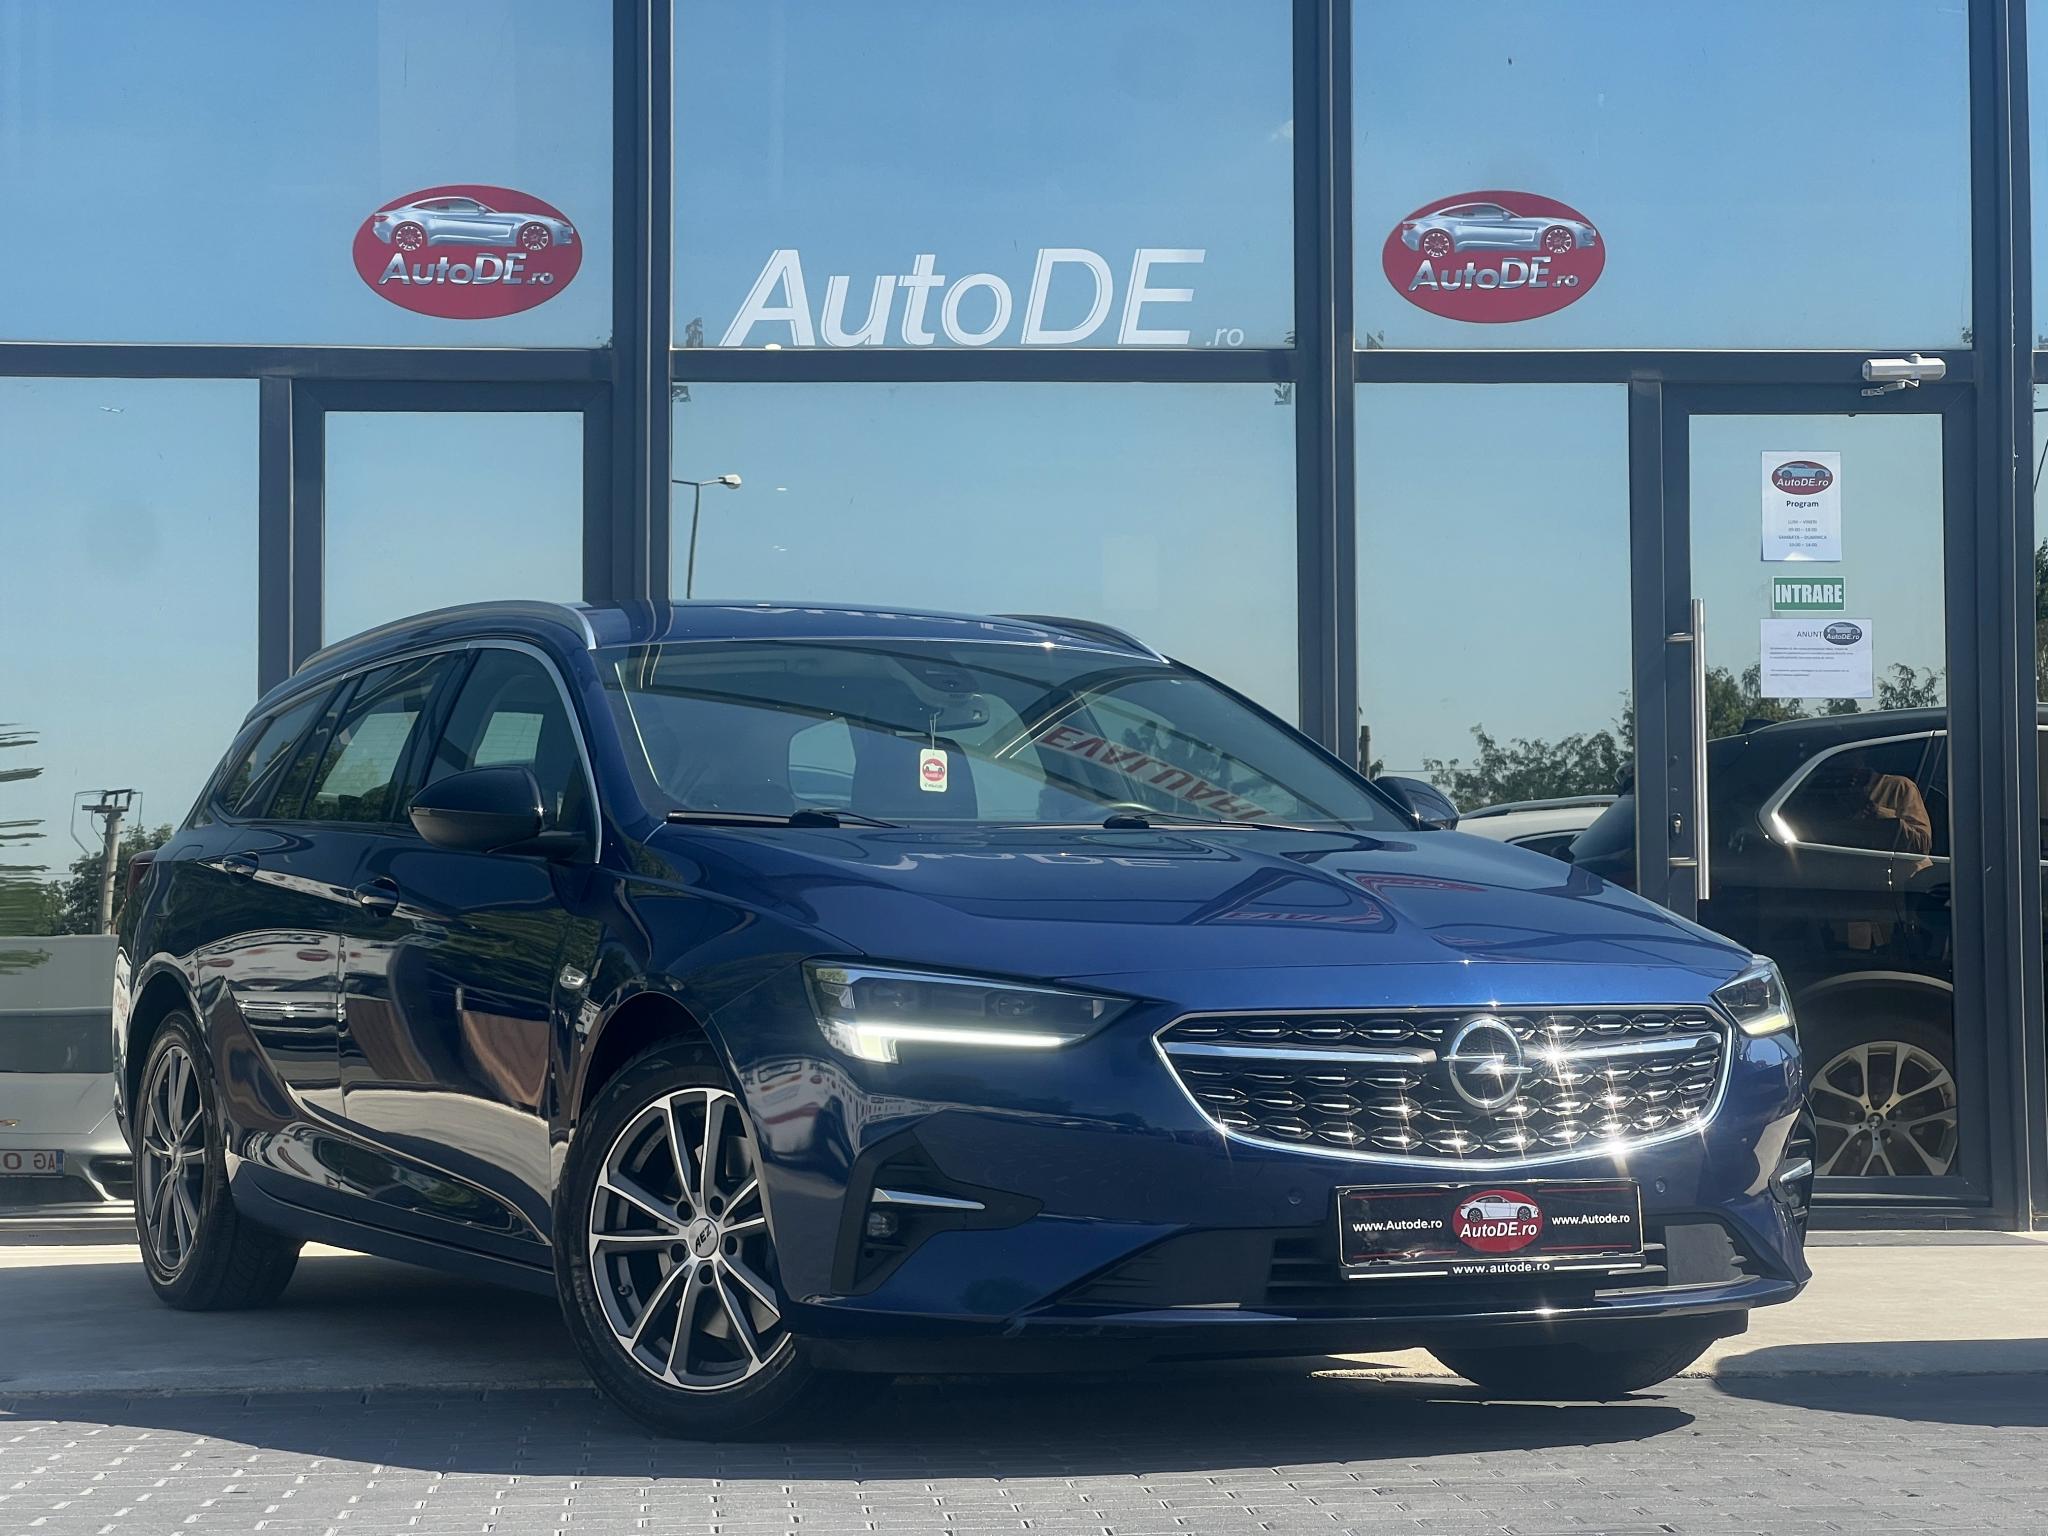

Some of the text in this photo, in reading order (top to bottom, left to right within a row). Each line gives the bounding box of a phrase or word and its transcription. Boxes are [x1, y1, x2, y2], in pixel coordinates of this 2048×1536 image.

[1776, 478, 1829, 487] AutoDE.ro
[1786, 500, 1819, 508] Program
[1775, 584, 1843, 603] INTRARE
[1352, 1218, 1443, 1232] www.Autode.ro
[1551, 1213, 1631, 1226] www.Autode.ro
[1460, 1221, 1538, 1239] AutoDE.ro
[695, 1223, 712, 1252] AEZ
[1452, 1261, 1550, 1274] www.autode.ro
